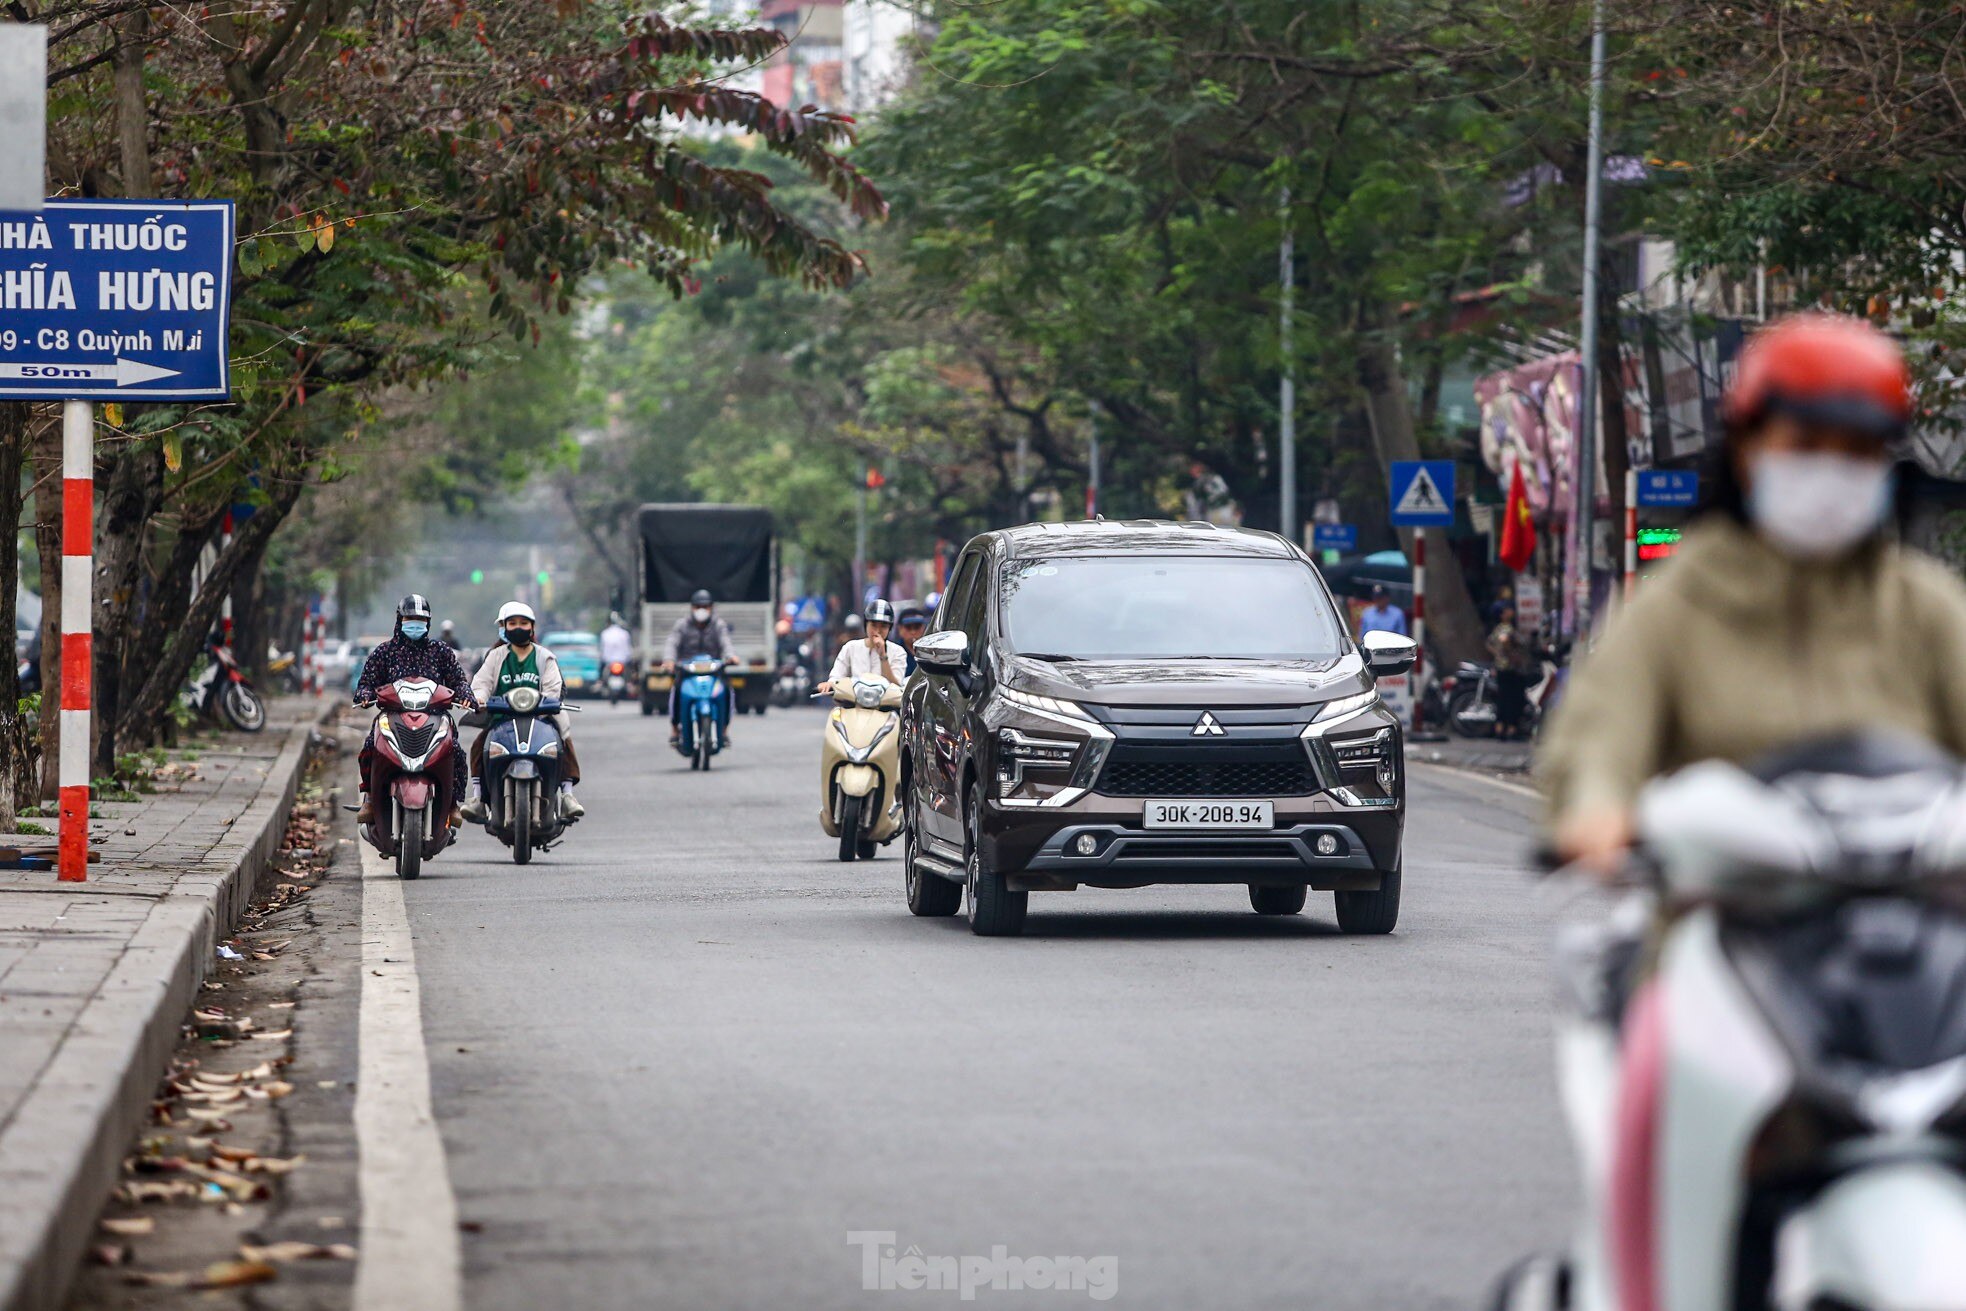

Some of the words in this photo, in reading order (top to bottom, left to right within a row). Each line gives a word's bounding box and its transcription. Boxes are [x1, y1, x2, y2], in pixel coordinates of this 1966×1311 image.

[0, 215, 53, 250] HÀ
[69, 214, 187, 251] THUỐC
[0, 263, 77, 310] HĨA
[98, 268, 215, 311] HƯNG
[0, 329, 17, 351] 9
[37, 328, 70, 351] C8
[77, 329, 152, 356] Quỳnh
[20, 366, 92, 378] 50m
[1156, 805, 1262, 823] 30K-208.94
